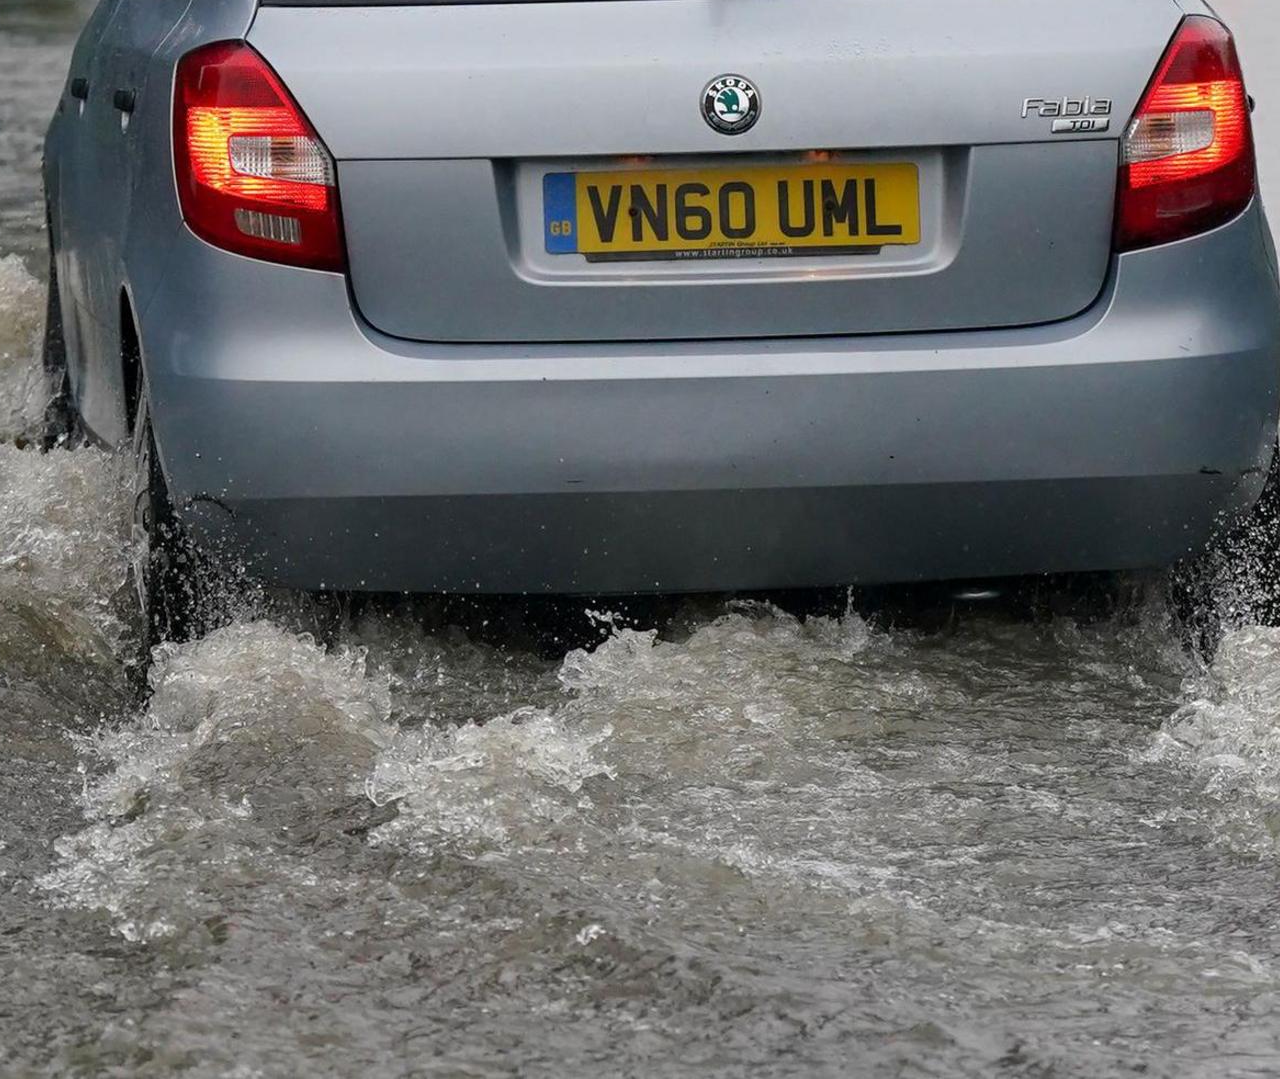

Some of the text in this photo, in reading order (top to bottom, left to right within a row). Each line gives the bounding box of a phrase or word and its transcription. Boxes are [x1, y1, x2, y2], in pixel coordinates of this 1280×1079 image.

[1021, 95, 1112, 118] Fabia
[1069, 119, 1095, 131] TDI
[586, 177, 903, 244] VN60 UML
[549, 220, 572, 237] GB
[675, 246, 794, 259] www.startingroup.co.uk
